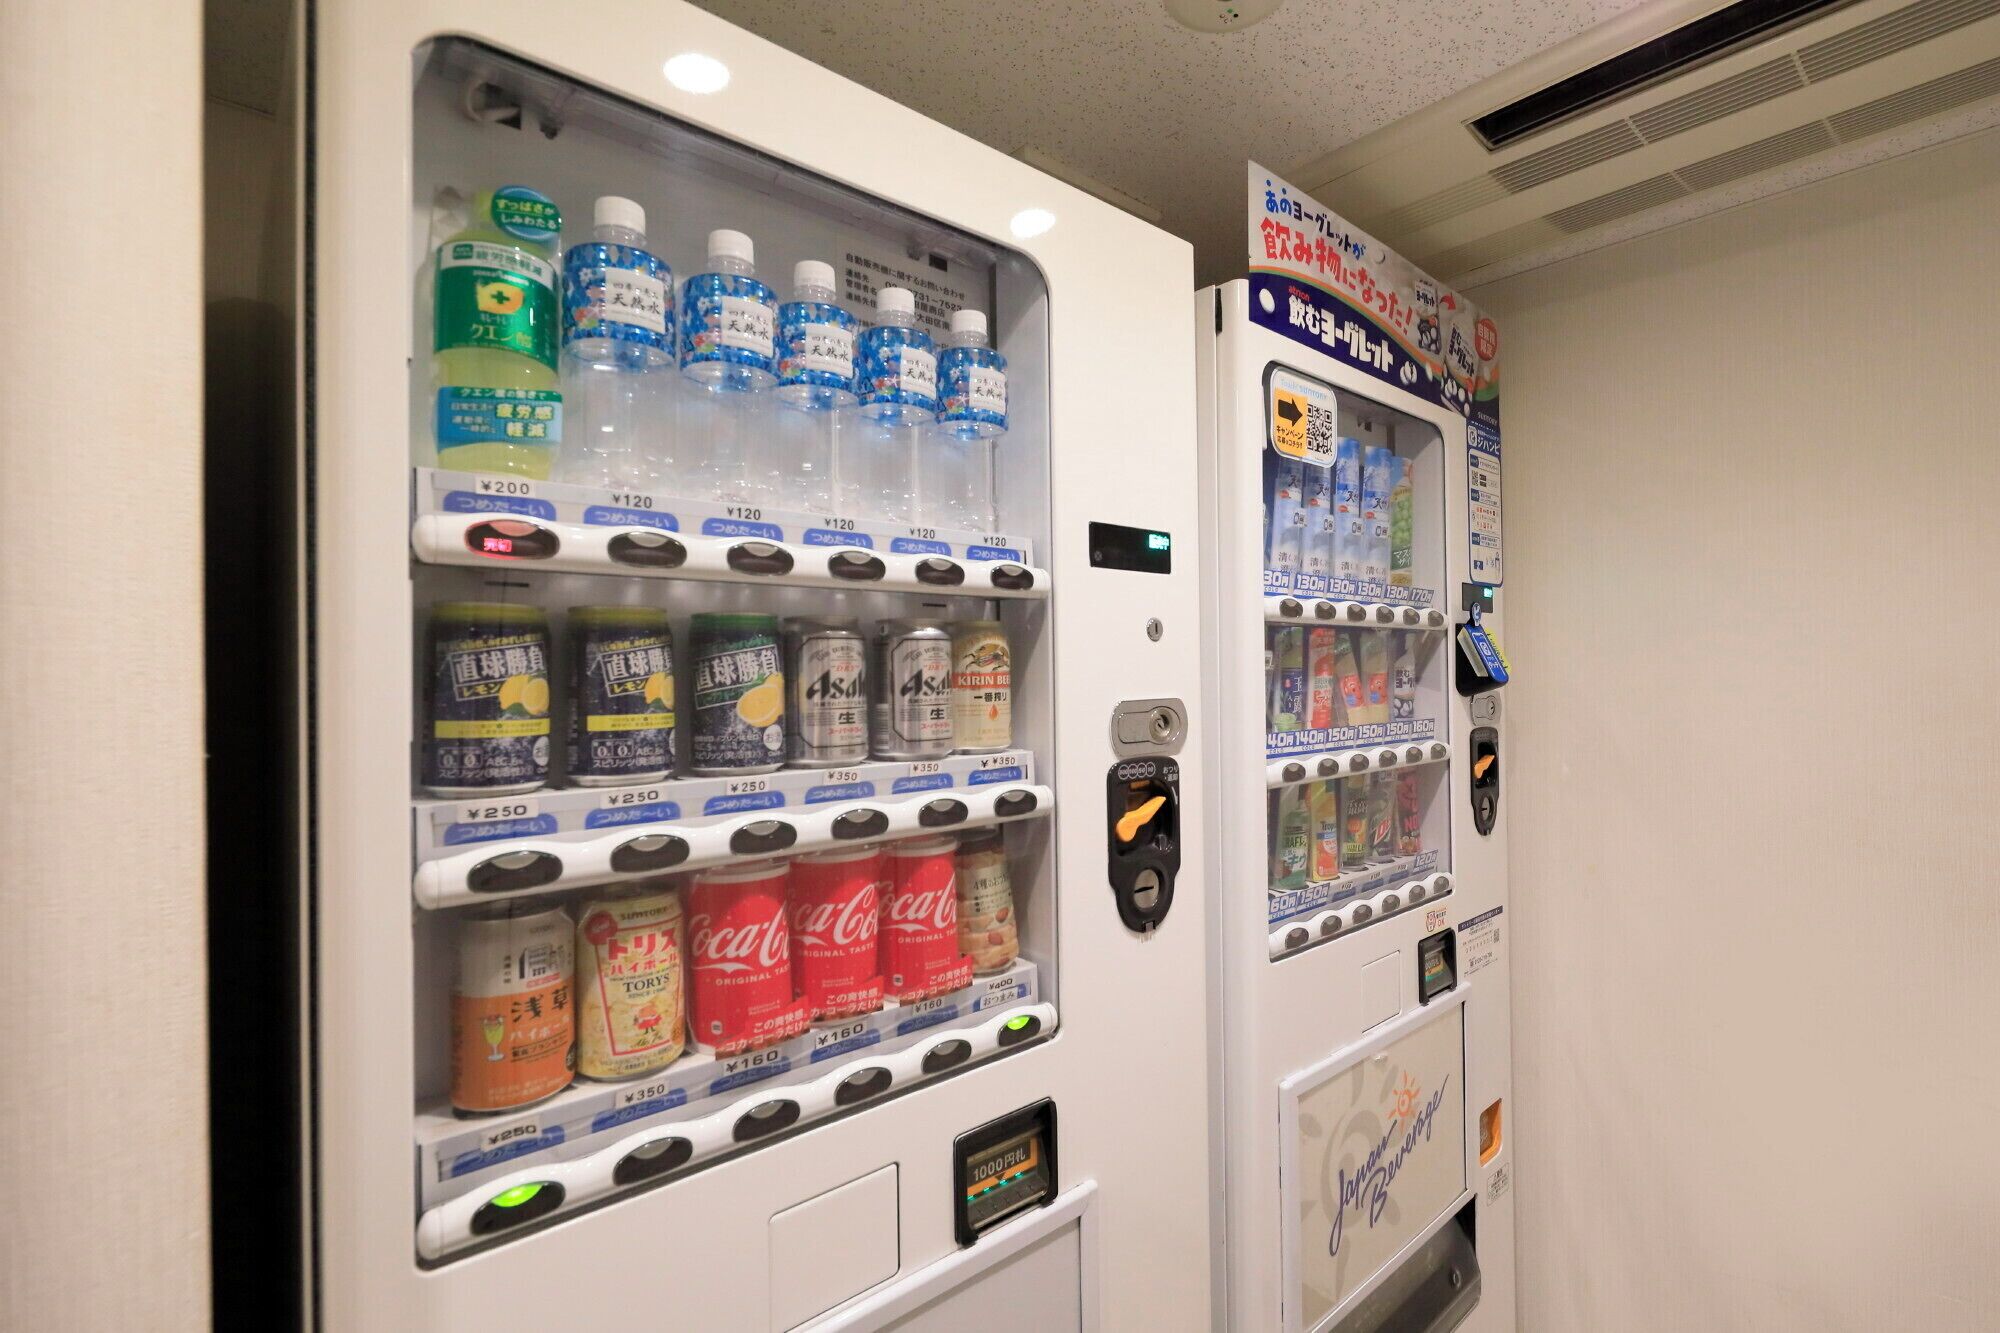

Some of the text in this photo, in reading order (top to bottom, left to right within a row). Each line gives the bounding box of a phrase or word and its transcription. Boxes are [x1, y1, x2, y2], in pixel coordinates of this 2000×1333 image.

[1265, 187, 1366, 260] あのヨーグレットが
[613, 293, 661, 315] 天然水
[728, 319, 770, 341] 天然水
[1289, 294, 1394, 373] 飲むヨーグレット
[810, 345, 850, 362] 天然水
[905, 367, 935, 385] 天然水
[1276, 424, 1304, 440] キャンペーン
[481, 480, 530, 495] ¥200
[612, 494, 653, 509] ¥120
[728, 507, 761, 521] ¥120
[825, 518, 855, 531] ¥120
[910, 528, 936, 540] ¥120
[983, 536, 1008, 548] ¥120
[1296, 573, 1325, 592] 130円
[1329, 578, 1355, 595] 130円
[1358, 581, 1382, 597] 130円
[1387, 585, 1409, 600] 130円
[456, 645, 545, 683] 直球勝負
[697, 648, 777, 691] 直球勝負
[612, 679, 649, 694] レモン
[958, 675, 994, 686] KIRIN
[463, 682, 502, 698] レモン
[973, 692, 1007, 703] 一番搾り
[838, 711, 856, 725] 生
[930, 708, 945, 720] 生
[1328, 726, 1355, 742] 150円
[1359, 724, 1383, 739] 150円
[1387, 721, 1409, 736] 150円
[1295, 729, 1324, 746] 140円
[912, 763, 939, 773] ¥350
[992, 756, 1017, 767] ¥350
[827, 770, 858, 782] ¥350
[731, 781, 766, 793] ¥250
[608, 790, 659, 805] ¥250
[467, 805, 527, 820] ¥250
[1300, 883, 1329, 906] 150円
[620, 904, 675, 921] SUNTORY
[608, 926, 678, 961] トリス
[897, 933, 944, 944] ORIGINAL
[610, 953, 678, 976] ハイボール
[623, 972, 671, 993] TORYS
[716, 973, 772, 986] ORIGINAL
[989, 978, 1013, 990] ¥400
[511, 985, 569, 1024] 浅草
[915, 999, 943, 1013] ¥160
[983, 990, 1016, 1007] おつまみ
[818, 1023, 864, 1046] ¥160
[726, 1050, 779, 1073] ¥160
[624, 1085, 666, 1104] ¥350
[488, 1124, 538, 1145] ¥250
[1361, 1072, 1450, 1229] Beverage
[974, 1147, 1027, 1182] 1000円札
